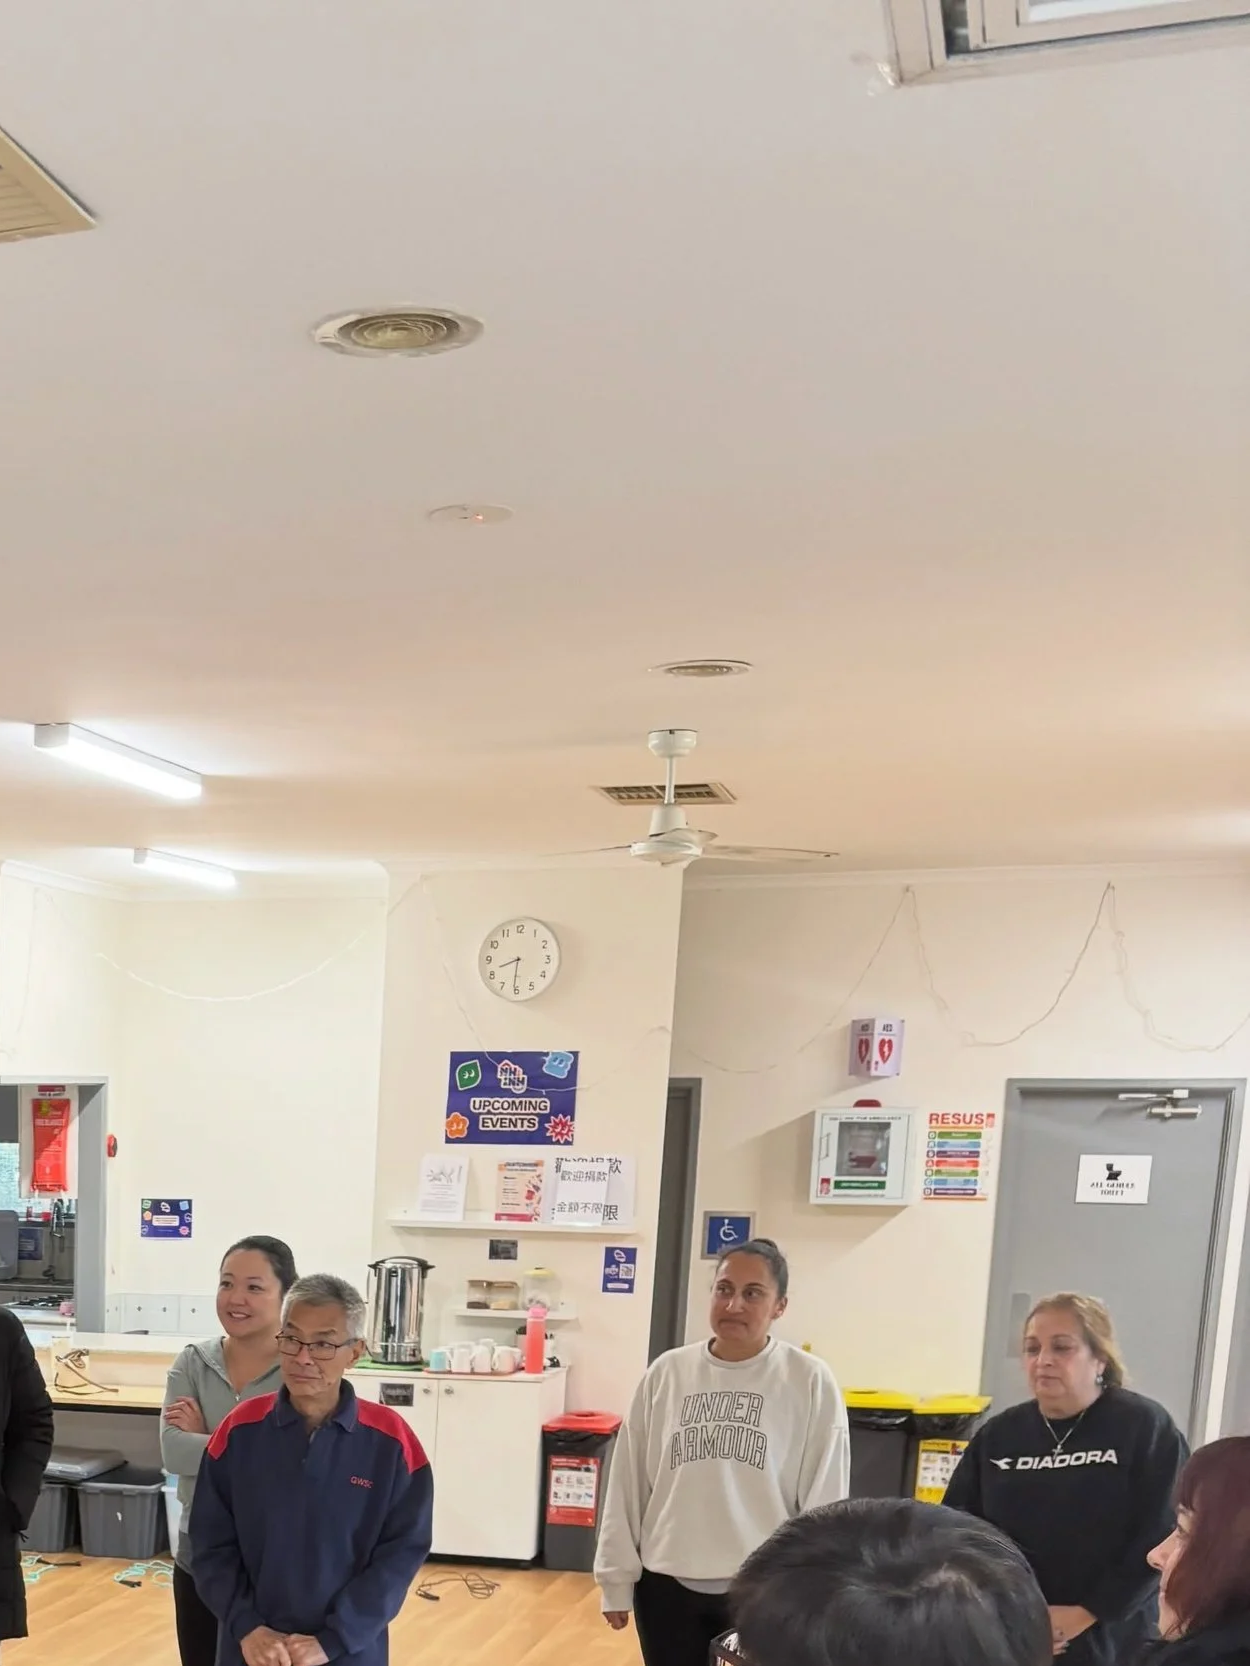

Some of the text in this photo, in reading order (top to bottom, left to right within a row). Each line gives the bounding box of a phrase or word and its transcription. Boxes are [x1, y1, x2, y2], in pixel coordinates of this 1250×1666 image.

[516, 924, 525, 934] 12
[490, 940, 499, 950] 10
[472, 1100, 548, 1111] UPCOMING
[481, 1117, 536, 1129] EVENTS
[929, 1112, 985, 1125] RESUS
[680, 1391, 764, 1427] UNDER
[670, 1424, 767, 1470] ARMOUR
[1015, 1449, 1118, 1470] DIADORA
